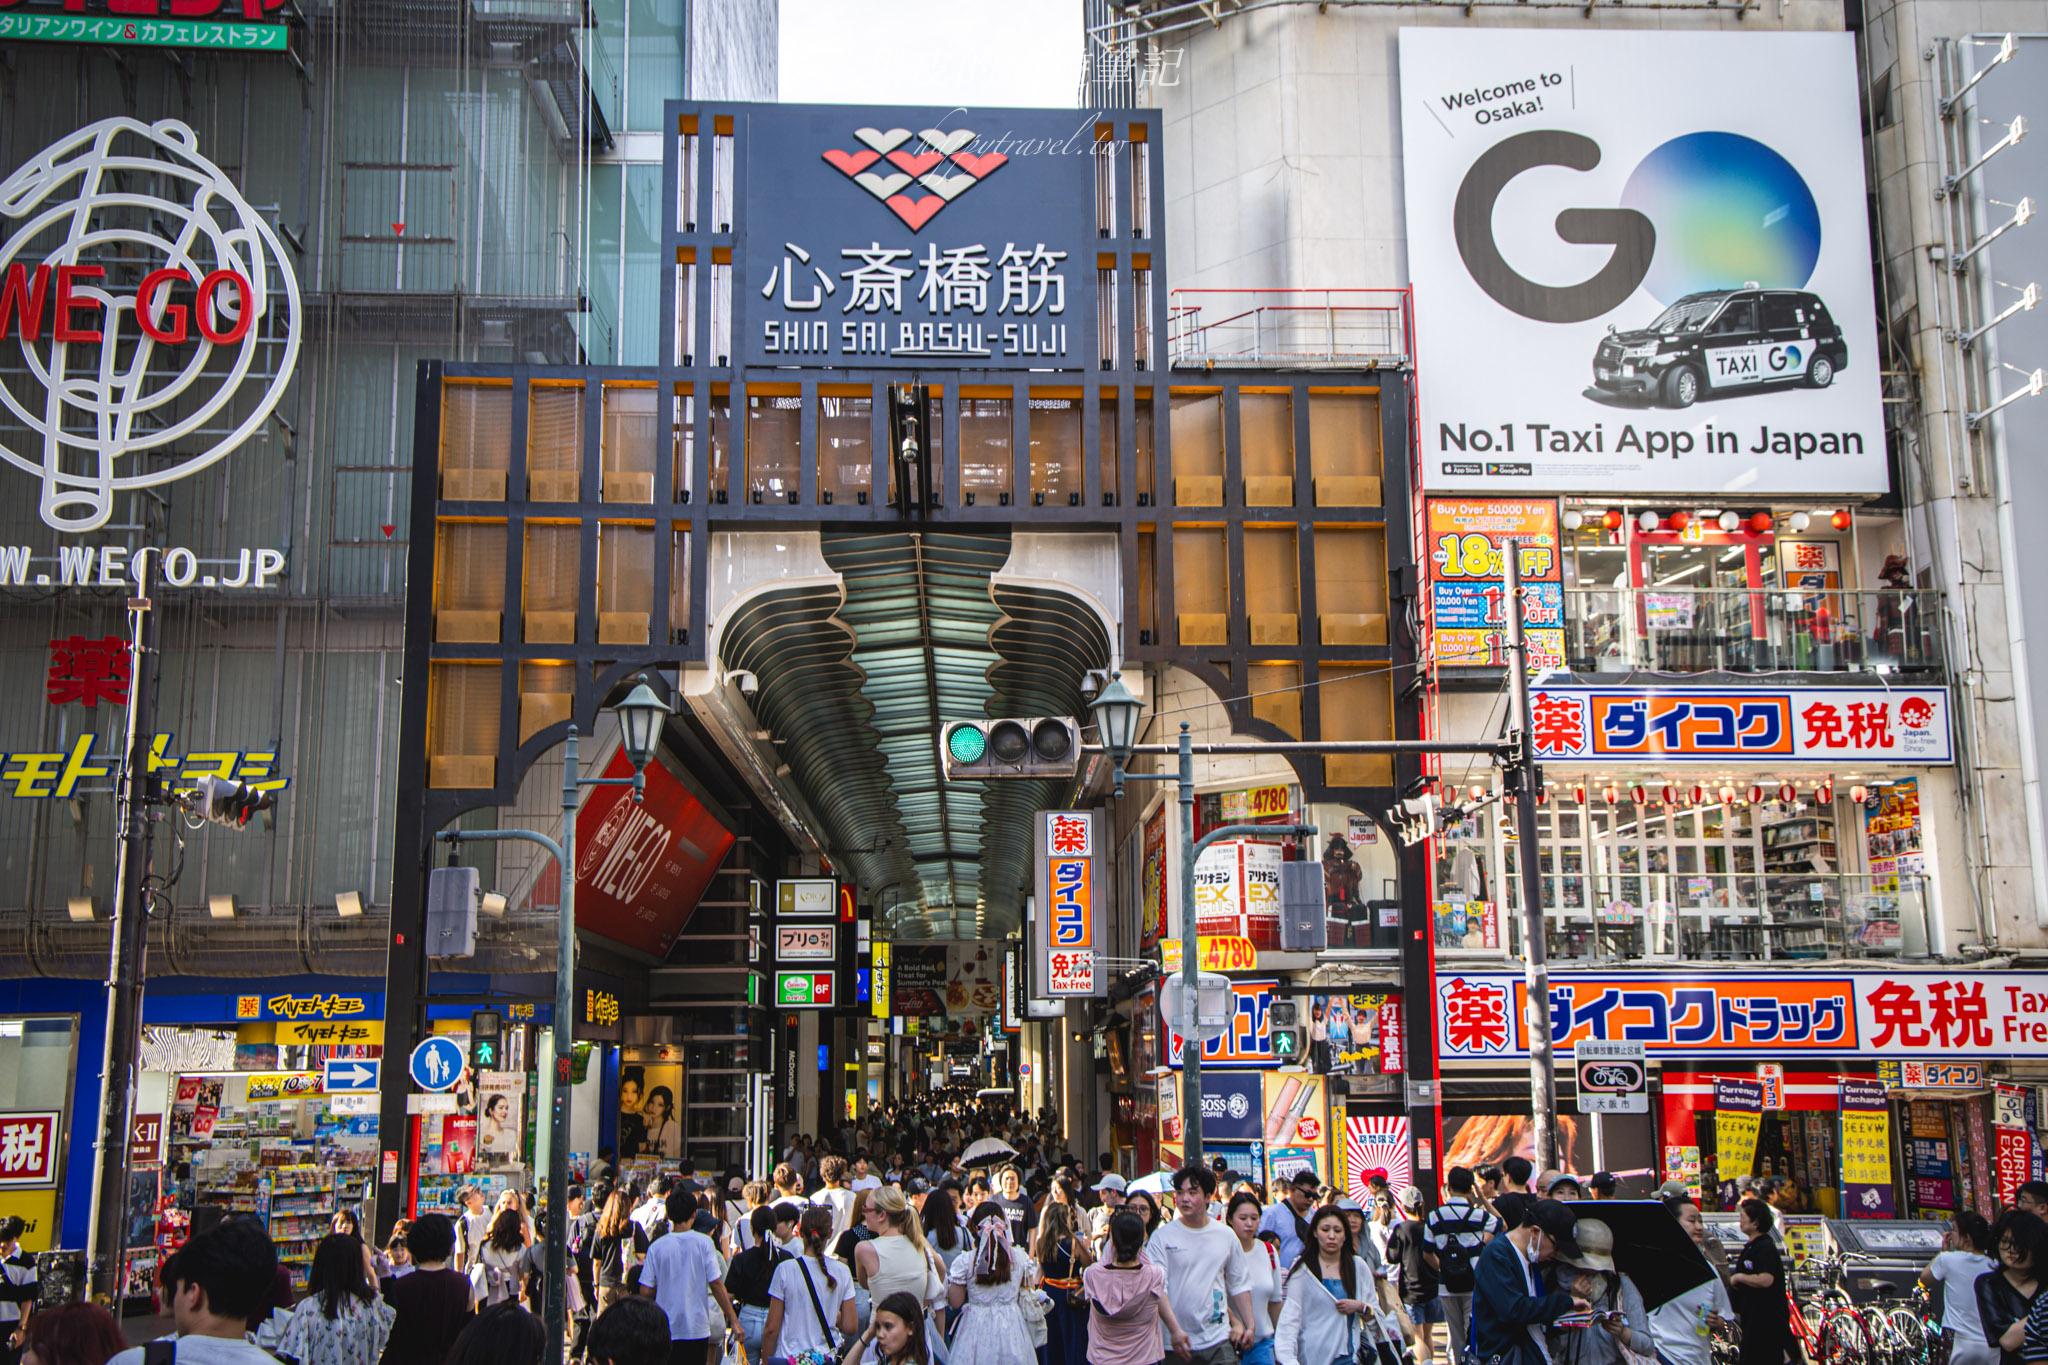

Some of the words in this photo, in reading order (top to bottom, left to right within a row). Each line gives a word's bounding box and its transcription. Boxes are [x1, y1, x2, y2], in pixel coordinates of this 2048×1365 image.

[1442, 77, 1537, 111] Welcome
[1540, 71, 1563, 87] to
[1475, 95, 1545, 126] Osaka!
[1454, 129, 1822, 324] GO
[761, 242, 1068, 315] 心斎橋筋
[764, 321, 829, 353] SHIN
[842, 321, 887, 354] SAI
[1716, 354, 1757, 376] TAXI
[1769, 345, 1802, 371] GO
[1440, 423, 1514, 453] No.1
[1526, 423, 1601, 453] Taxi
[1616, 424, 1694, 460] App
[1706, 425, 1738, 454] in
[1750, 425, 1864, 461] Japan
[1438, 505, 1456, 516] Buy
[1460, 504, 1484, 514] Over
[1526, 505, 1545, 514] Yen
[1796, 544, 1825, 570] 薬
[1439, 587, 1453, 596] Buy
[1455, 587, 1473, 595] Over
[1464, 597, 1478, 605] Yen
[1529, 609, 1559, 622] OFF
[1441, 634, 1455, 643] Buy
[1458, 634, 1475, 642] Over
[1532, 656, 1561, 669] OFF
[1532, 692, 1583, 753] 薬
[1605, 701, 1781, 749] ダイコク
[1802, 701, 1895, 750] 免税
[1903, 729, 1932, 737] Japan.
[1904, 745, 1926, 753] Shop
[1350, 819, 1376, 827] Welcome
[1054, 816, 1086, 853] 薬
[1351, 833, 1376, 841] Japan
[1056, 862, 1084, 943] ダイコク
[1051, 953, 1091, 979] 免税
[815, 985, 829, 994] 6F
[1052, 980, 1092, 990] Tax-Free
[239, 997, 258, 1016] 薬
[270, 995, 365, 1017] マツモトキヨシ
[1354, 994, 1368, 1005] 2F
[1447, 978, 1506, 1049] 薬
[1867, 980, 1993, 1048] 免税
[294, 1024, 370, 1042] マツモトキヨシ
[1381, 1003, 1401, 1071] 打卡景点
[1878, 1061, 1899, 1070] 3F
[1879, 1069, 1900, 1079] 2F
[1905, 1062, 1922, 1084] 薬
[1927, 1065, 1979, 1085] ダイコク
[1719, 1084, 1760, 1097] Currency
[1845, 1085, 1886, 1096] Currency
[1597, 1097, 1630, 1109] 大阪市
[1719, 1095, 1761, 1106] Exchange
[1845, 1096, 1886, 1105] Exchange
[1299, 1119, 1315, 1127] NOW
[1301, 1131, 1319, 1139] SALE!
[1359, 1134, 1397, 1145] 期間限定
[0, 1123, 44, 1172] 税
[2012, 1136, 2026, 1185] CURR
[2001, 1135, 2015, 1205] EXCHAN
